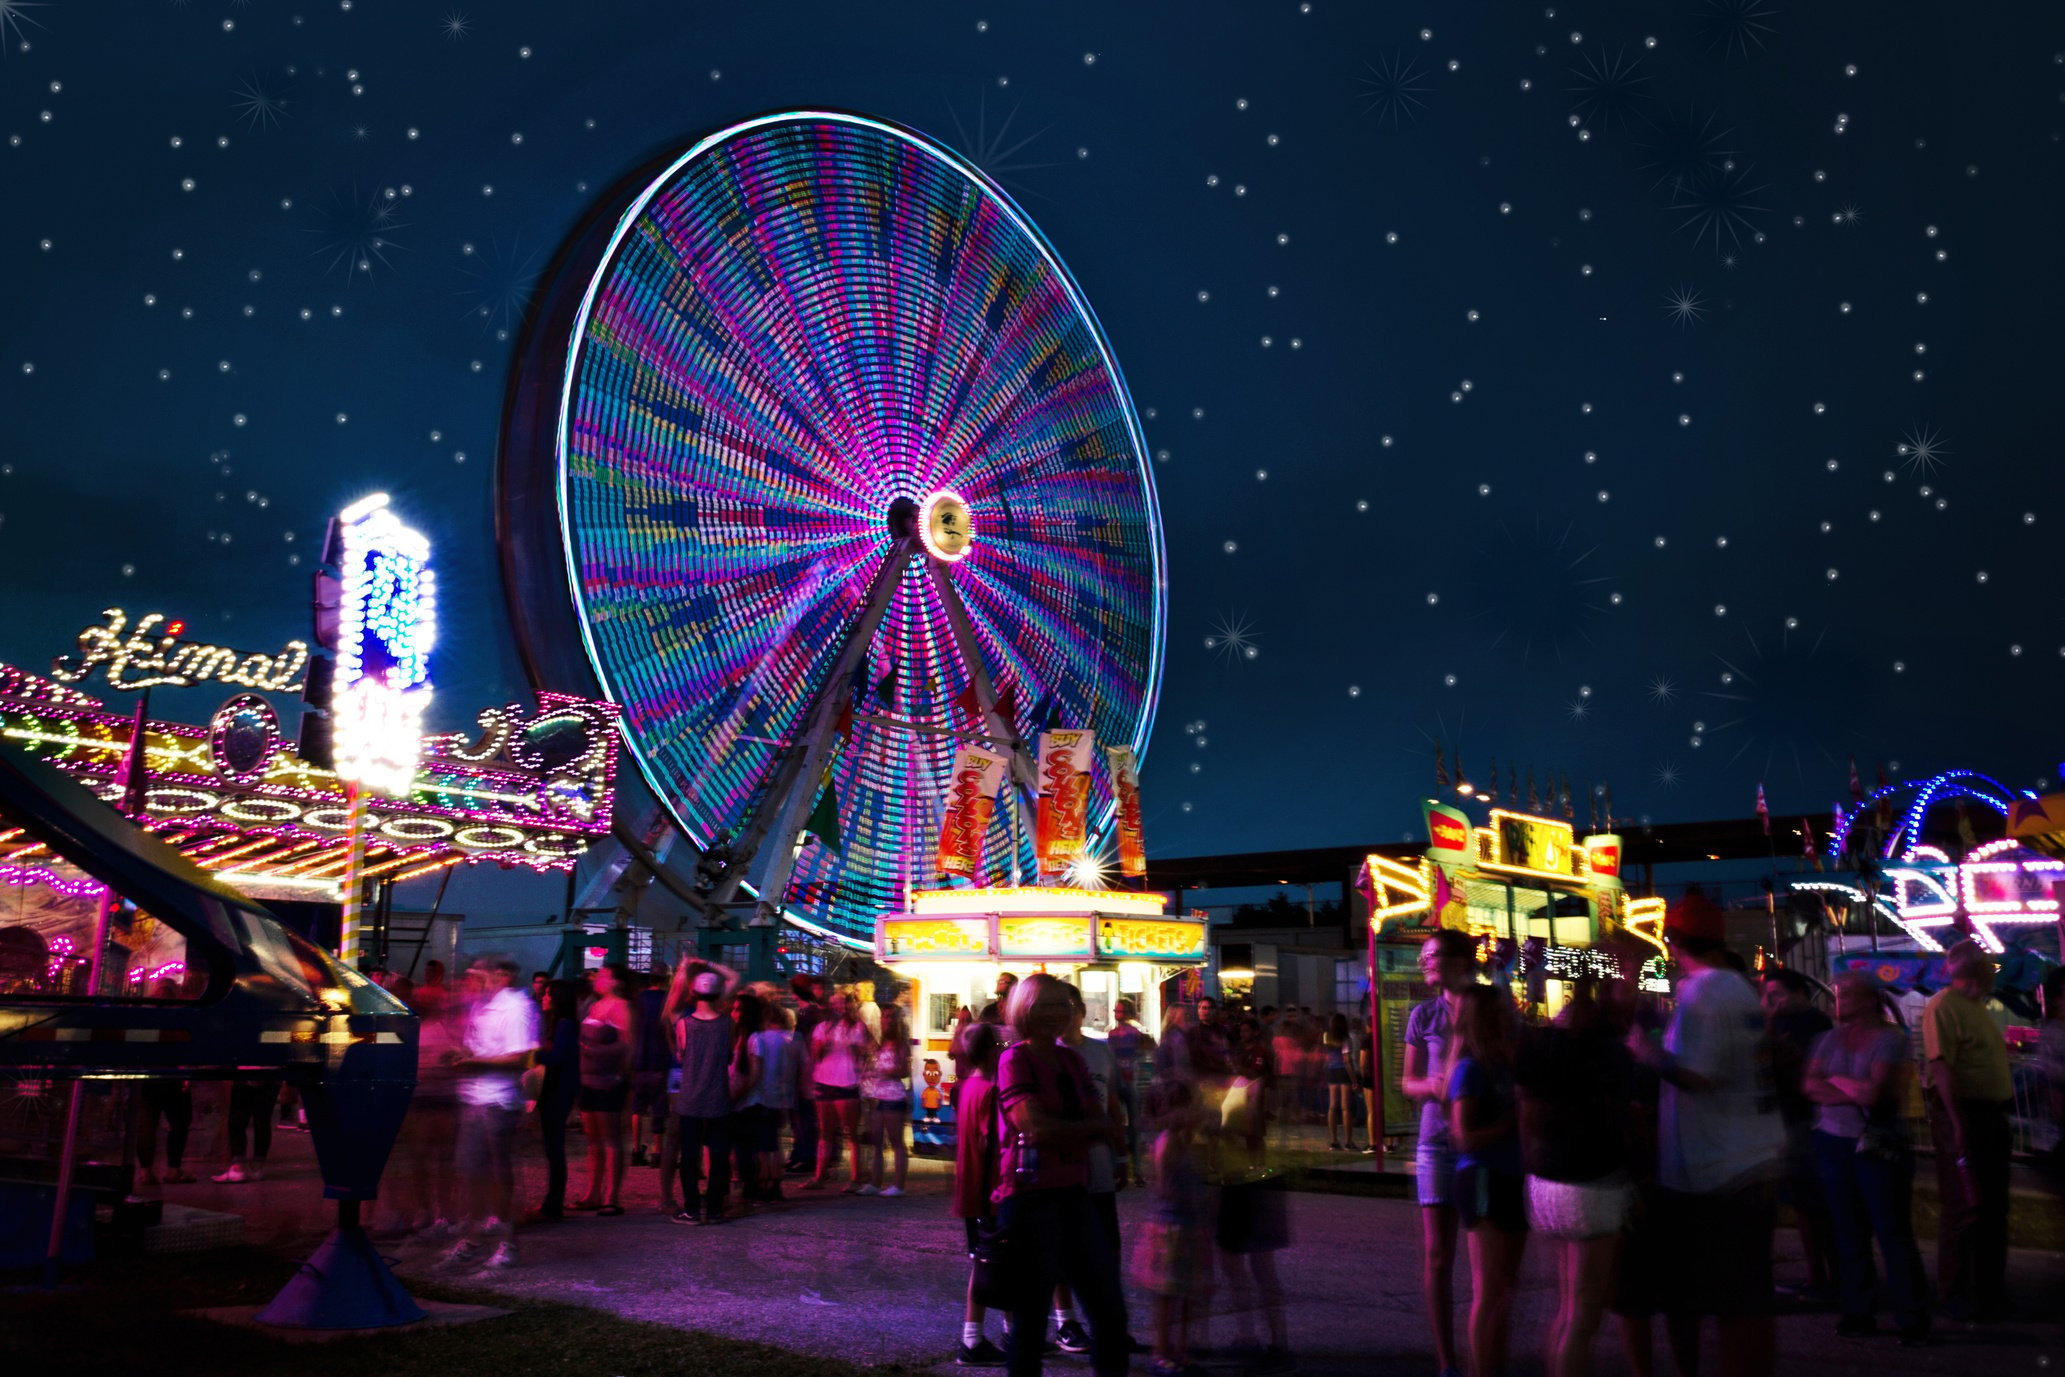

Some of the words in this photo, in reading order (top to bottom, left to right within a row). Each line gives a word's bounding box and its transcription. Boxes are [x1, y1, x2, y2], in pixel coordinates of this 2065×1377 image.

[1049, 732, 1083, 748] BUY
[966, 755, 993, 771] BUY
[944, 856, 975, 873] HERE
